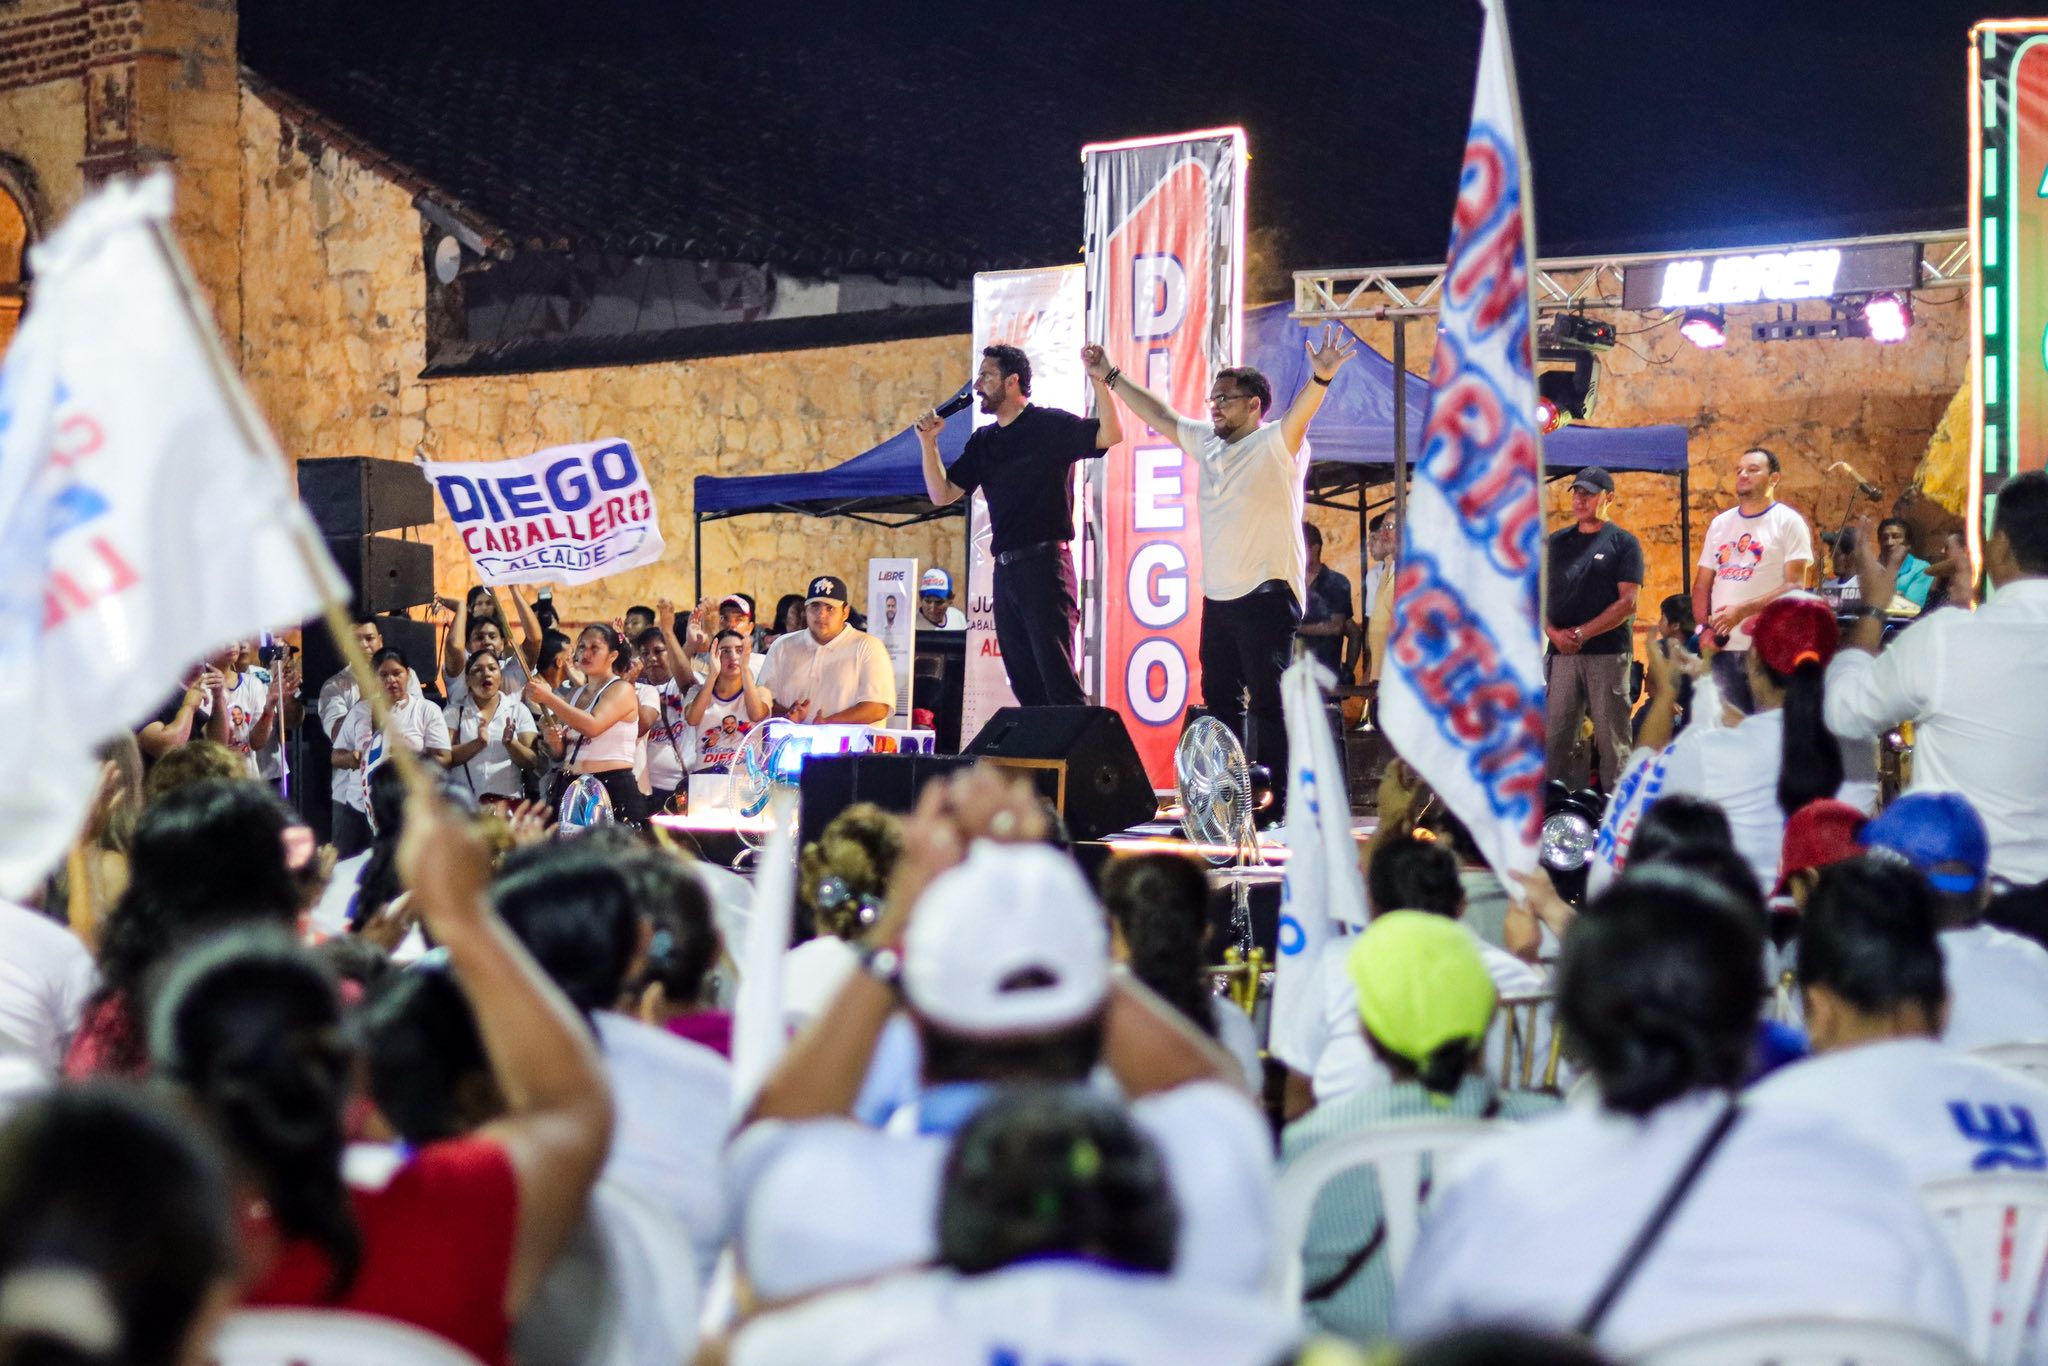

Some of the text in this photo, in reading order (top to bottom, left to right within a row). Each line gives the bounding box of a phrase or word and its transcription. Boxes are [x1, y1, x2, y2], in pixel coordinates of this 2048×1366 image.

[435, 442, 638, 523] DIEGO
[1125, 252, 1190, 729] DIEGO
[462, 489, 650, 555] CABALLERO
[508, 544, 607, 571] ALCALDE
